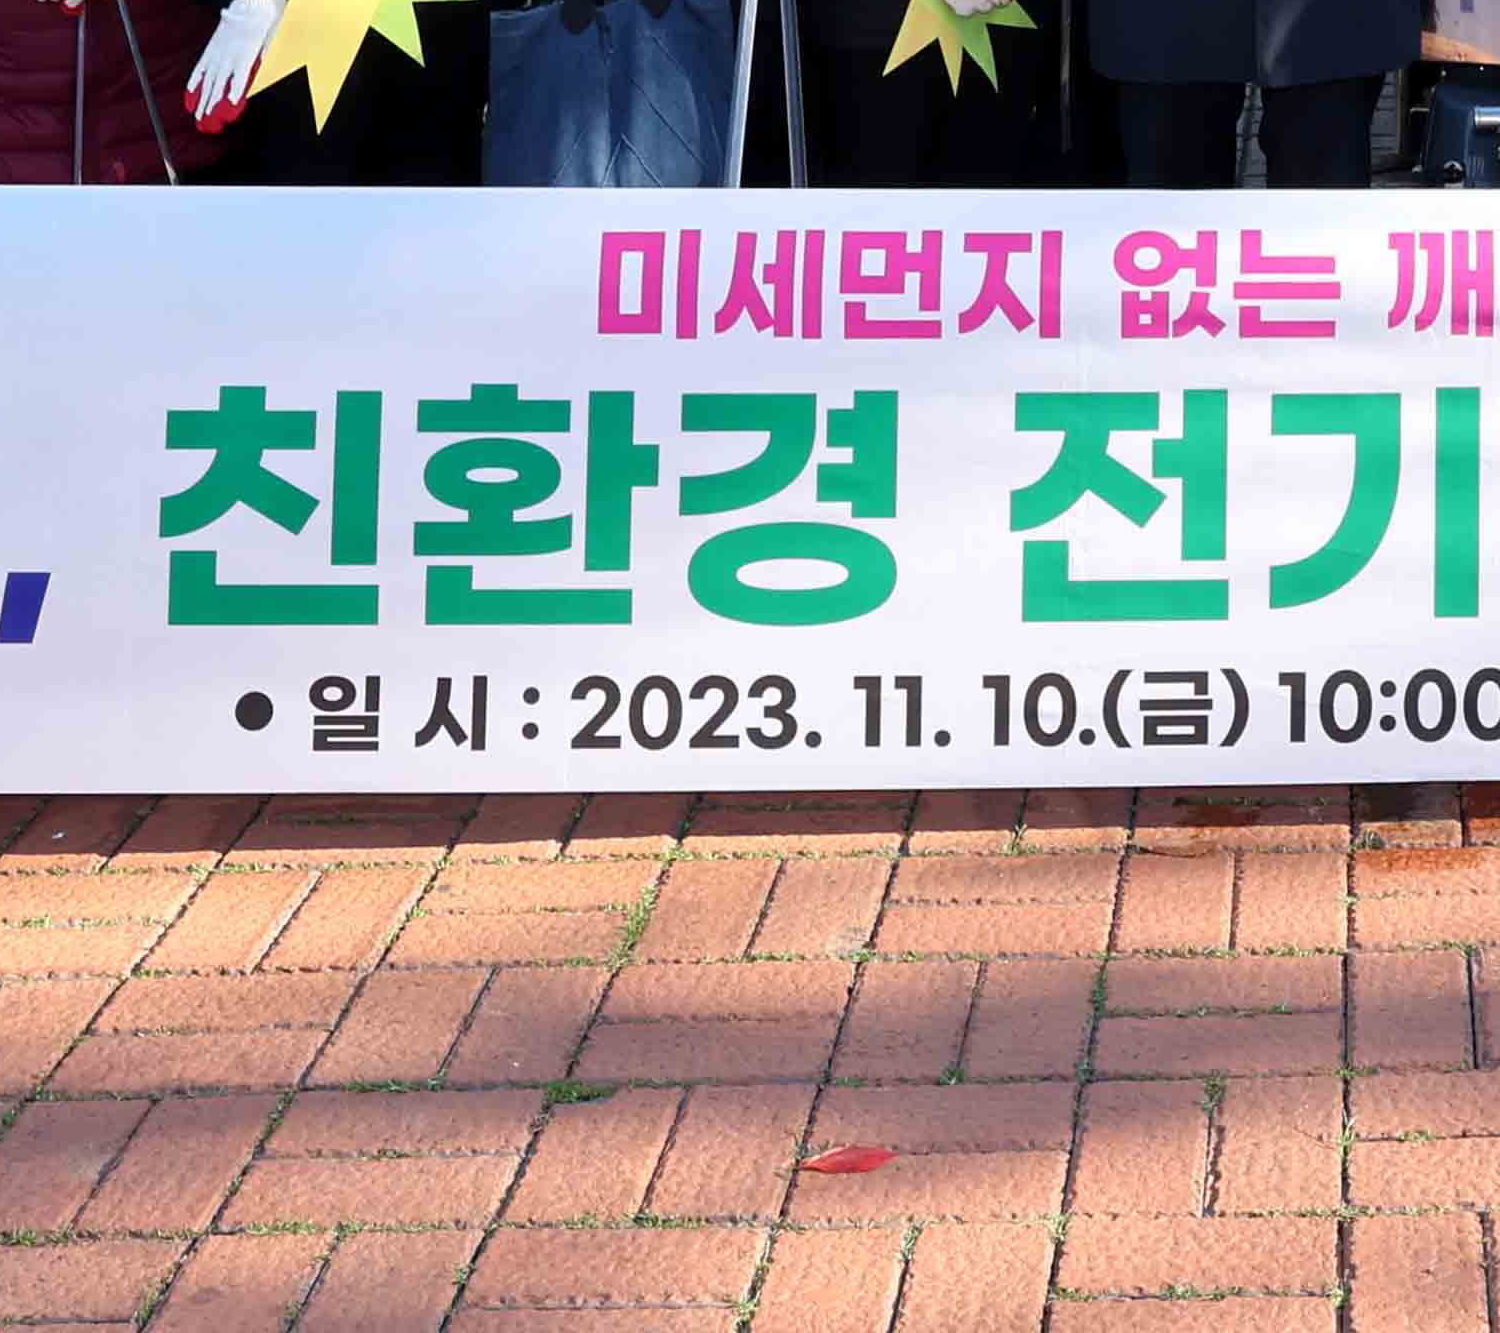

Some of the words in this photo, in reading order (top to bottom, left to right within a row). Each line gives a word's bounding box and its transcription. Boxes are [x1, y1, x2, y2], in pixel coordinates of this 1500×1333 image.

[596, 229, 1060, 341] 미세먼지
[1110, 226, 1341, 340] 없는
[158, 381, 901, 628] 친환경
[568, 675, 823, 752] 2023.
[853, 673, 951, 747] 11.
[980, 668, 1253, 753] 10.(금)
